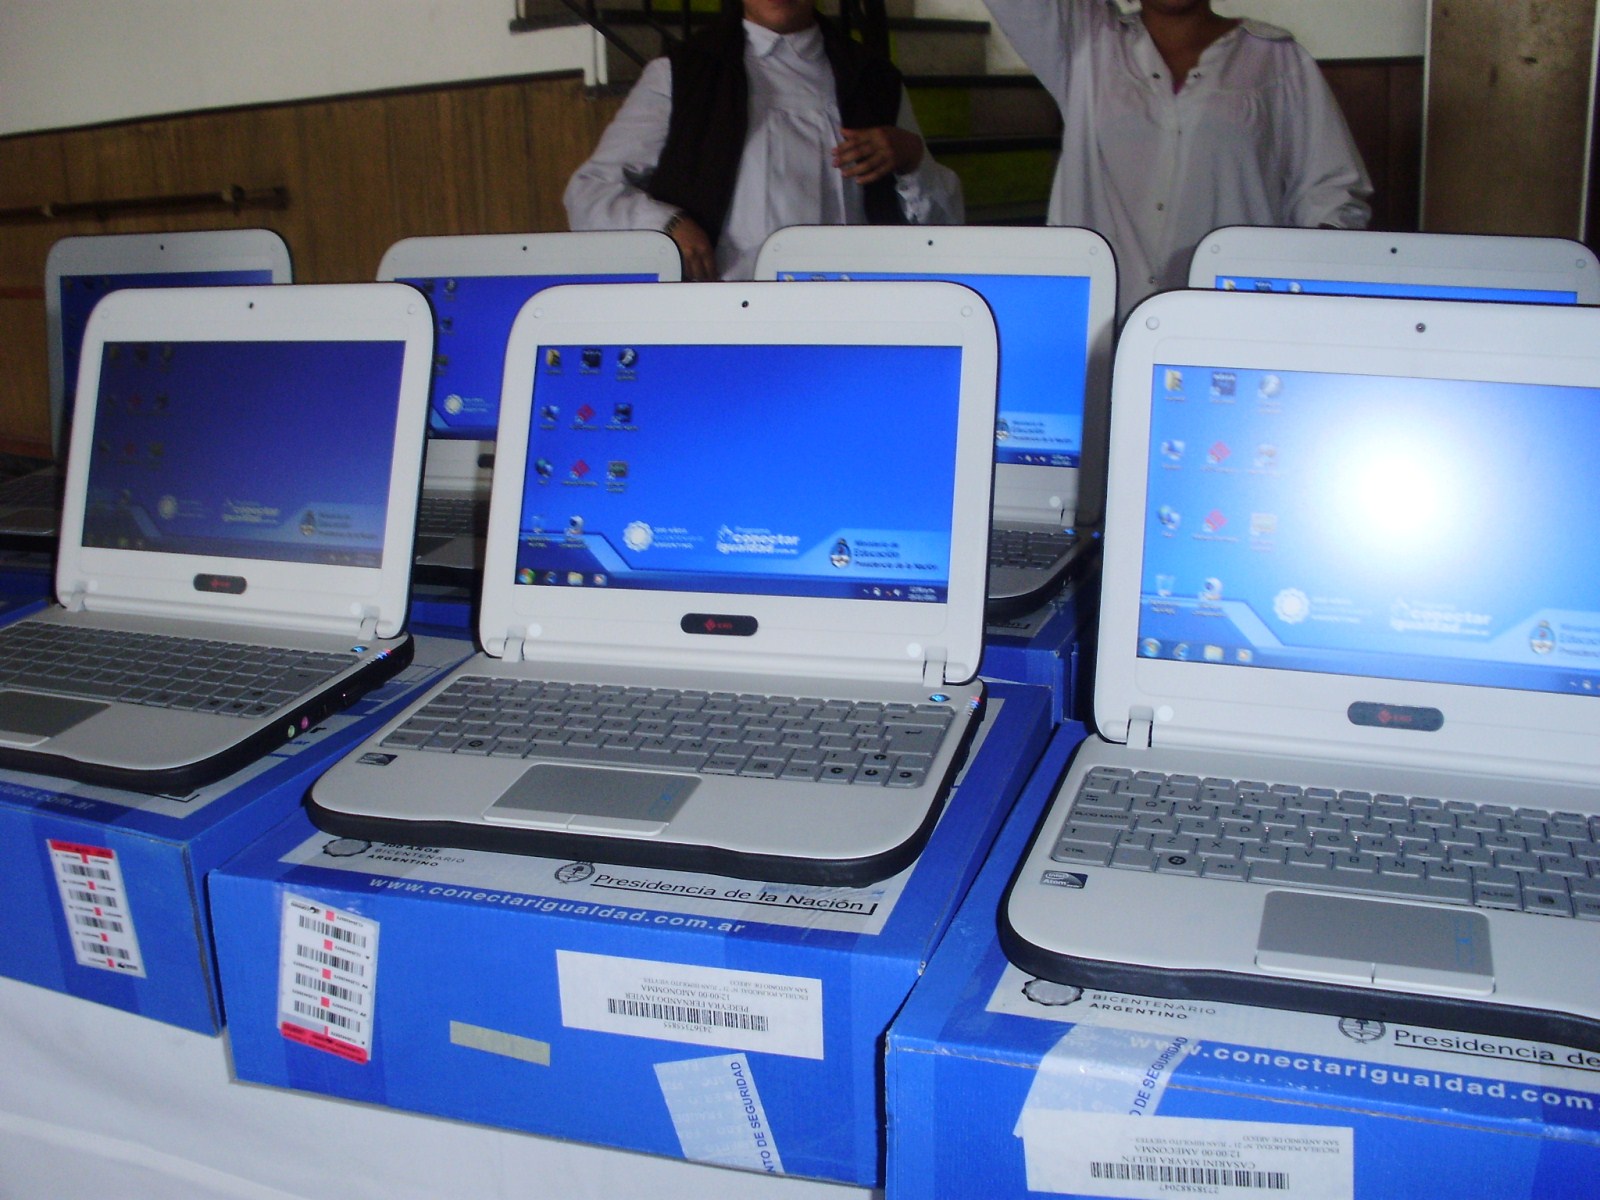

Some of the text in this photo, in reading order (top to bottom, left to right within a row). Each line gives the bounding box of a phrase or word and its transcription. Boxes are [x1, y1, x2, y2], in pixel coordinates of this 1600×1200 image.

[367, 854, 439, 867] ARGENTINO
[375, 848, 465, 864] BICENTENARIO
[594, 873, 864, 911] Presidencia de la Nación
[370, 877, 746, 934] www.conectarigualdad.com.ar
[625, 992, 655, 1001] JAVIER
[657, 996, 705, 1008] FERNANDO
[1092, 993, 1217, 1015] BICENTENARIO
[1089, 1002, 1189, 1020] ARGENTINO
[1394, 1029, 1600, 1068] Presidencia de
[1134, 1036, 1188, 1109] SEGURIDAD DE
[731, 1061, 761, 1129] SEGURIDAD
[754, 1131, 768, 1147] DE
[1160, 1157, 1200, 1166] MAYRA
[1203, 1160, 1256, 1169] CASARINI
